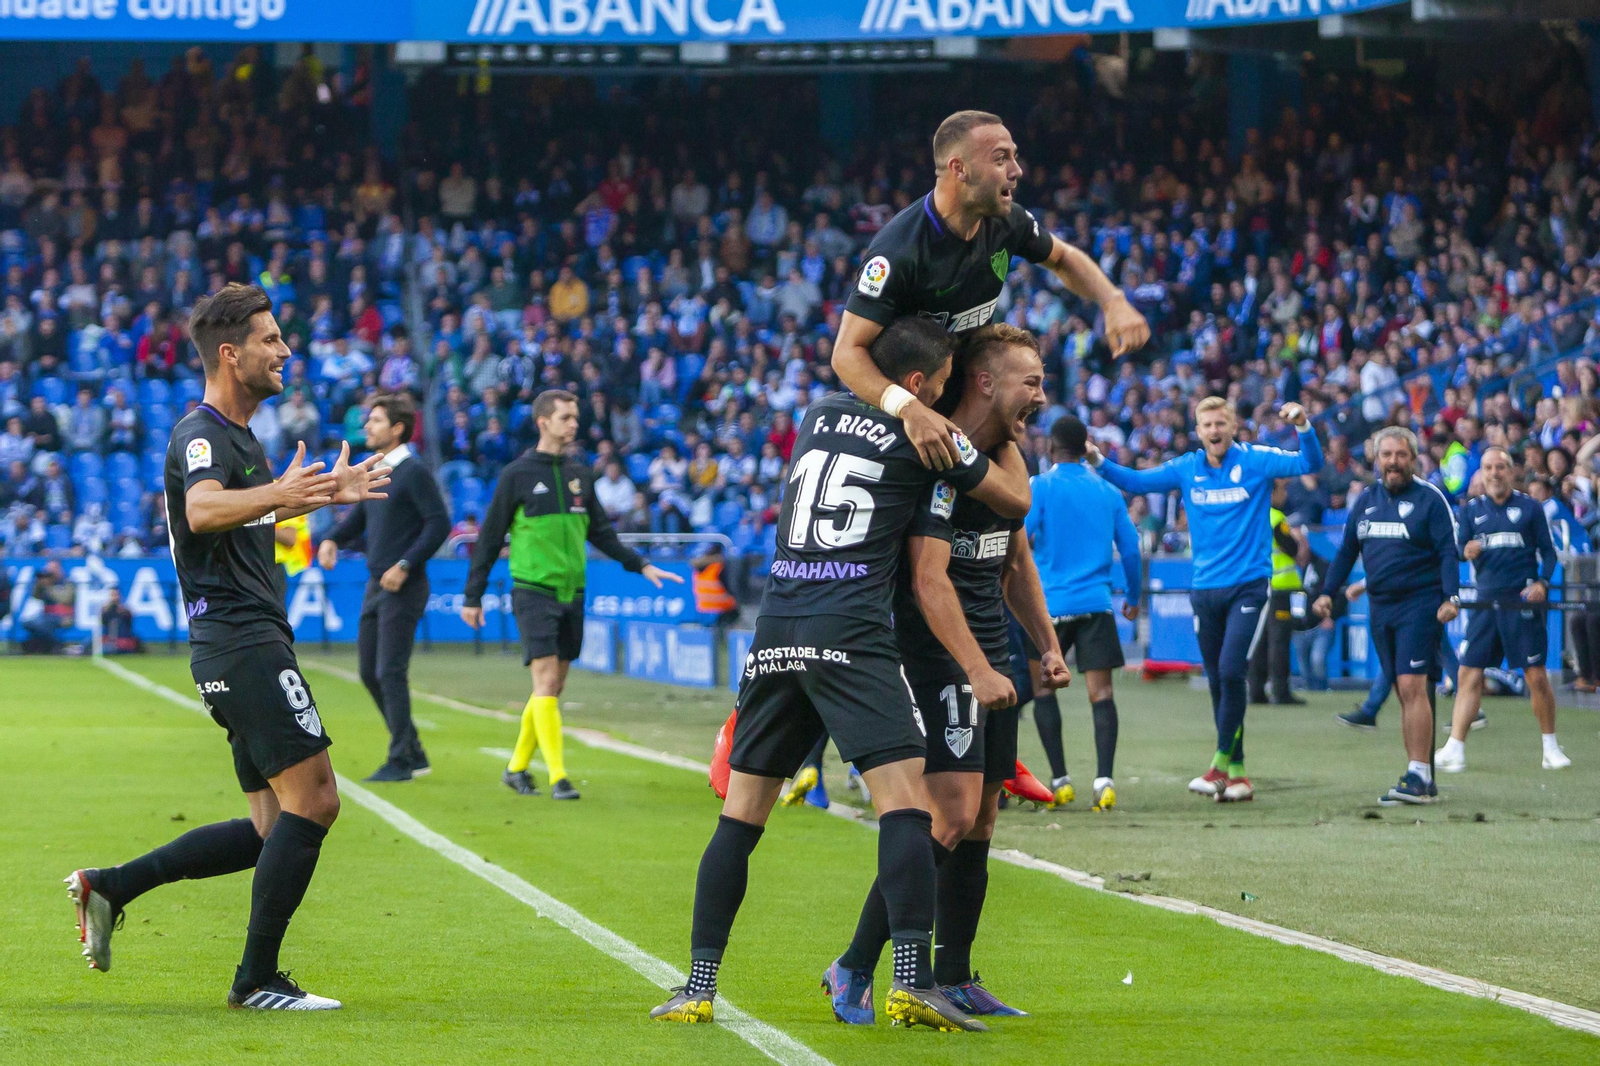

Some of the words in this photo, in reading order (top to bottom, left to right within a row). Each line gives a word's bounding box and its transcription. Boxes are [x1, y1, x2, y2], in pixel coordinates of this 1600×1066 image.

[500, 0, 786, 35] ABANCA
[889, 0, 1134, 31] ABANCA
[813, 415, 829, 435] F.
[835, 414, 897, 452] RICCA
[788, 449, 885, 549] 15
[976, 530, 1011, 559] TESE
[758, 659, 807, 675] MÁLAGA
[821, 649, 851, 664] SOL
[204, 680, 230, 693] SOL
[278, 668, 310, 710] 8
